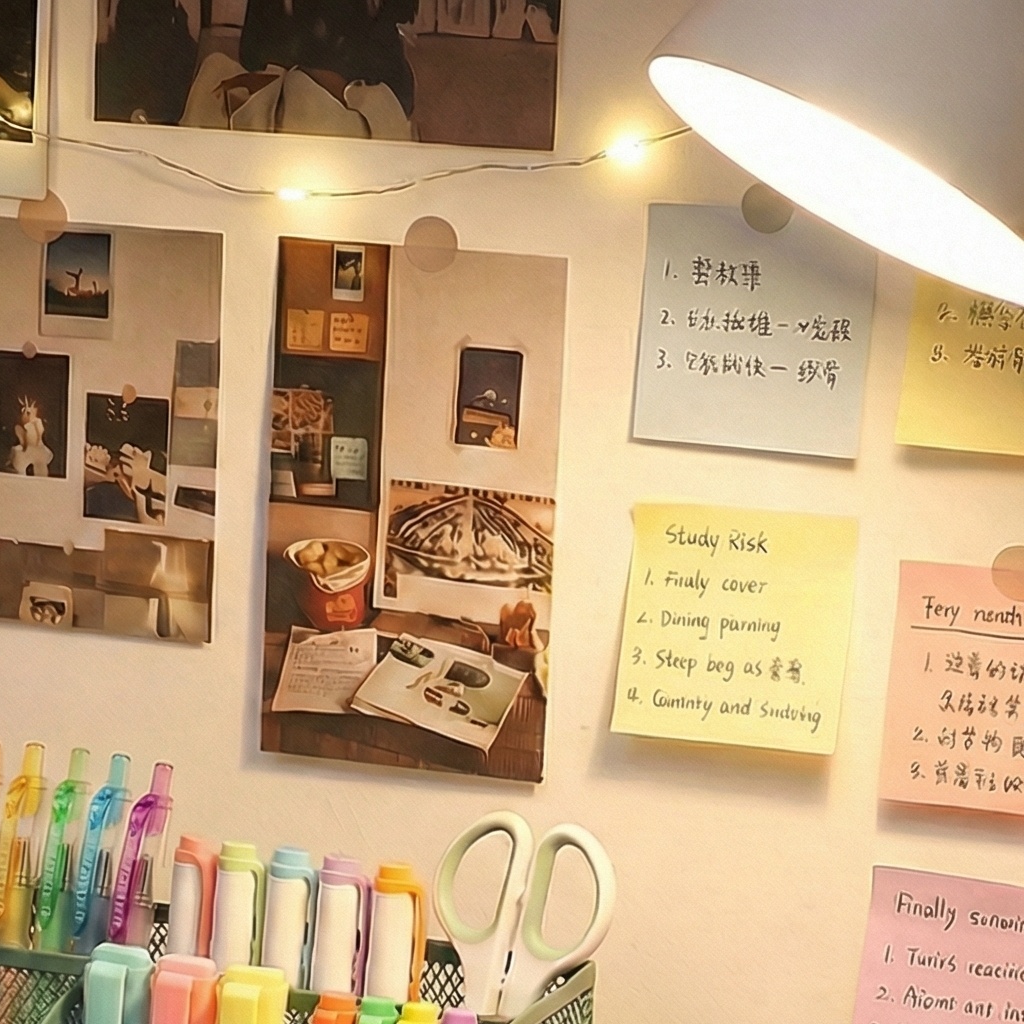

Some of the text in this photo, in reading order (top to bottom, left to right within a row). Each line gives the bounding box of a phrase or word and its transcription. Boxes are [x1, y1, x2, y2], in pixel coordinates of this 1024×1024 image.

[665, 523, 768, 557] Study Risk
[722, 578, 768, 593] cover
[632, 646, 646, 665] 3.
[707, 653, 735, 682] beg
[743, 663, 762, 677] as
[627, 687, 643, 705] 4.
[720, 697, 752, 716] and
[896, 891, 956, 931] Finally
[876, 986, 894, 1003] 2.
